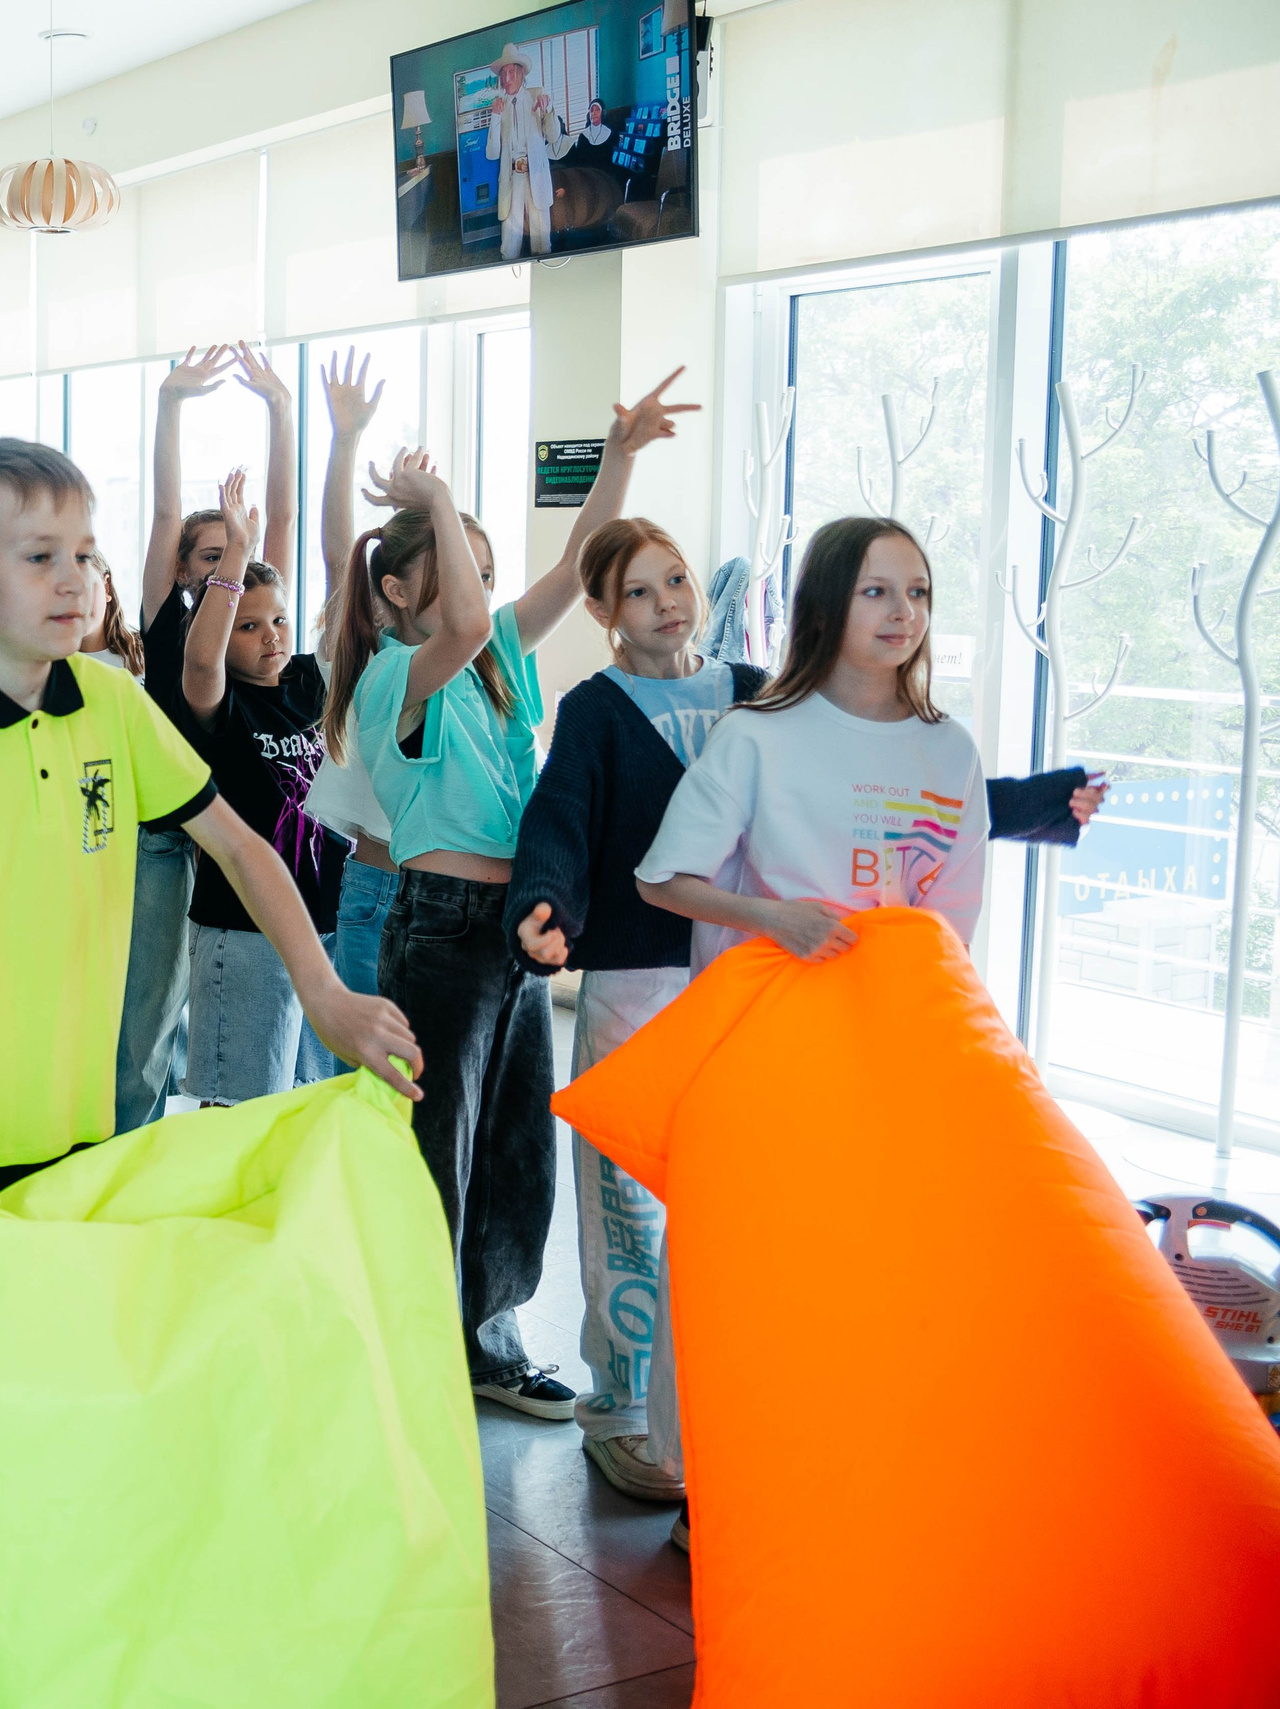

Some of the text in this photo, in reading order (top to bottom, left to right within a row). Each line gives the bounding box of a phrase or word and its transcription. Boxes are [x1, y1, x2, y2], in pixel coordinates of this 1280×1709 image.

[683, 95, 692, 148] DELUXE
[852, 784, 911, 798] WORK OUT
[853, 799, 878, 809] AND
[853, 814, 902, 827] YOU WILL
[852, 829, 879, 841] FEEL
[1074, 864, 1198, 902] ОТДЫХА
[1204, 1306, 1263, 1324] STIHL
[1214, 1320, 1244, 1332] SHE
